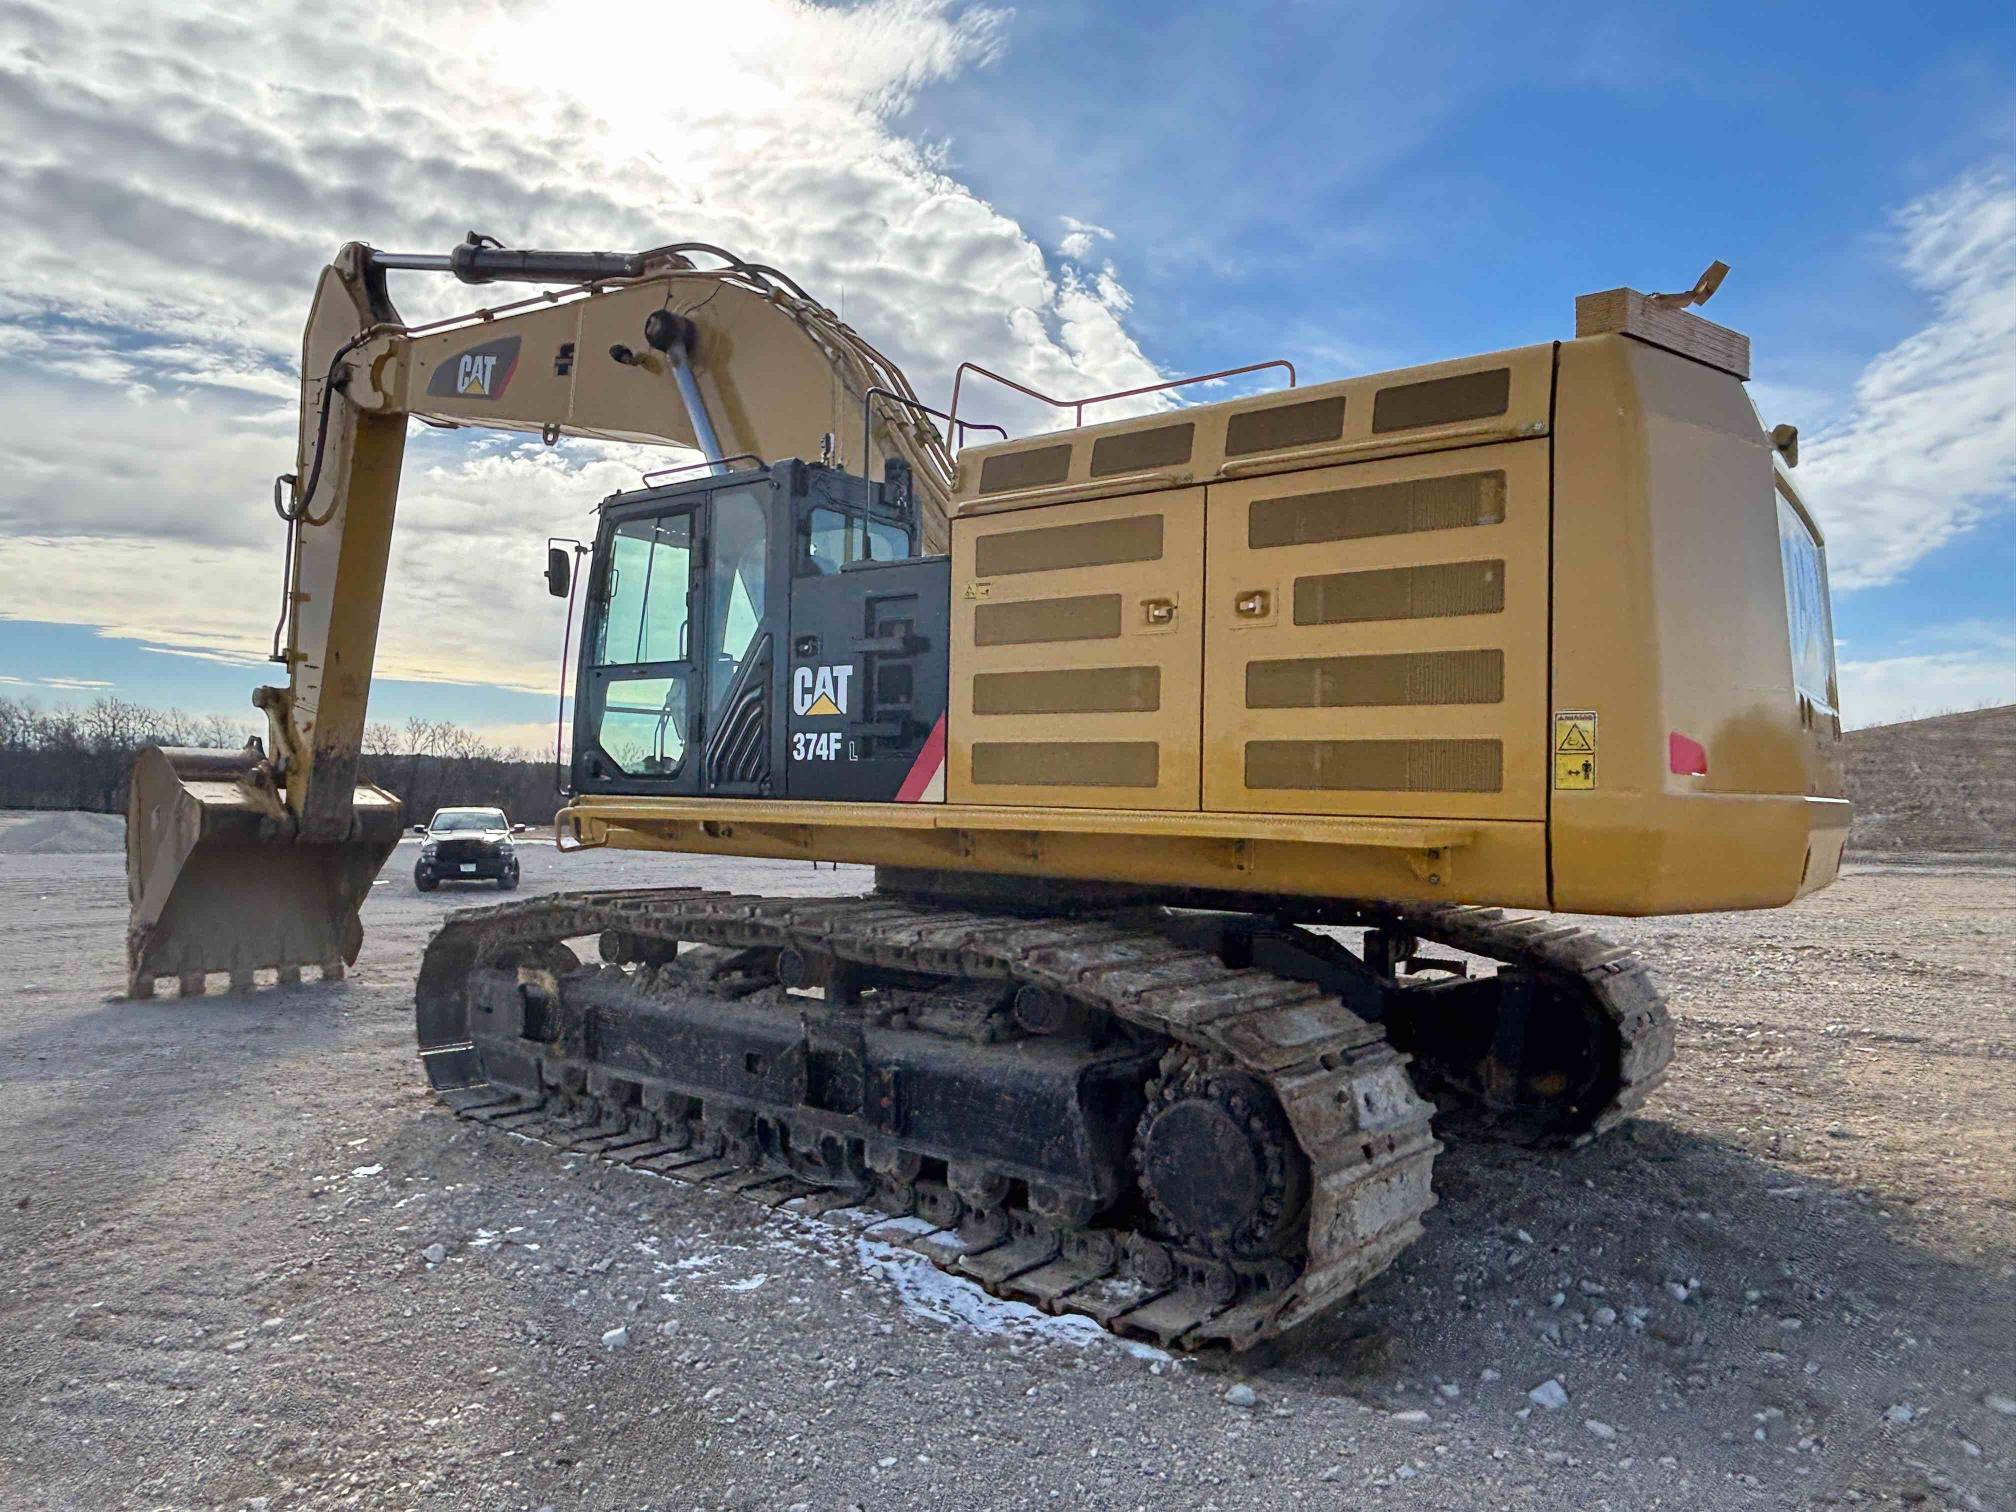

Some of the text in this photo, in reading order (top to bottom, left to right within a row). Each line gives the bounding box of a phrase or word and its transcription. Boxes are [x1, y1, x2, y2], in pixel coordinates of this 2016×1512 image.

[457, 354, 497, 395] CAT
[793, 665, 853, 716] CAT
[793, 732, 859, 762] 374F L
